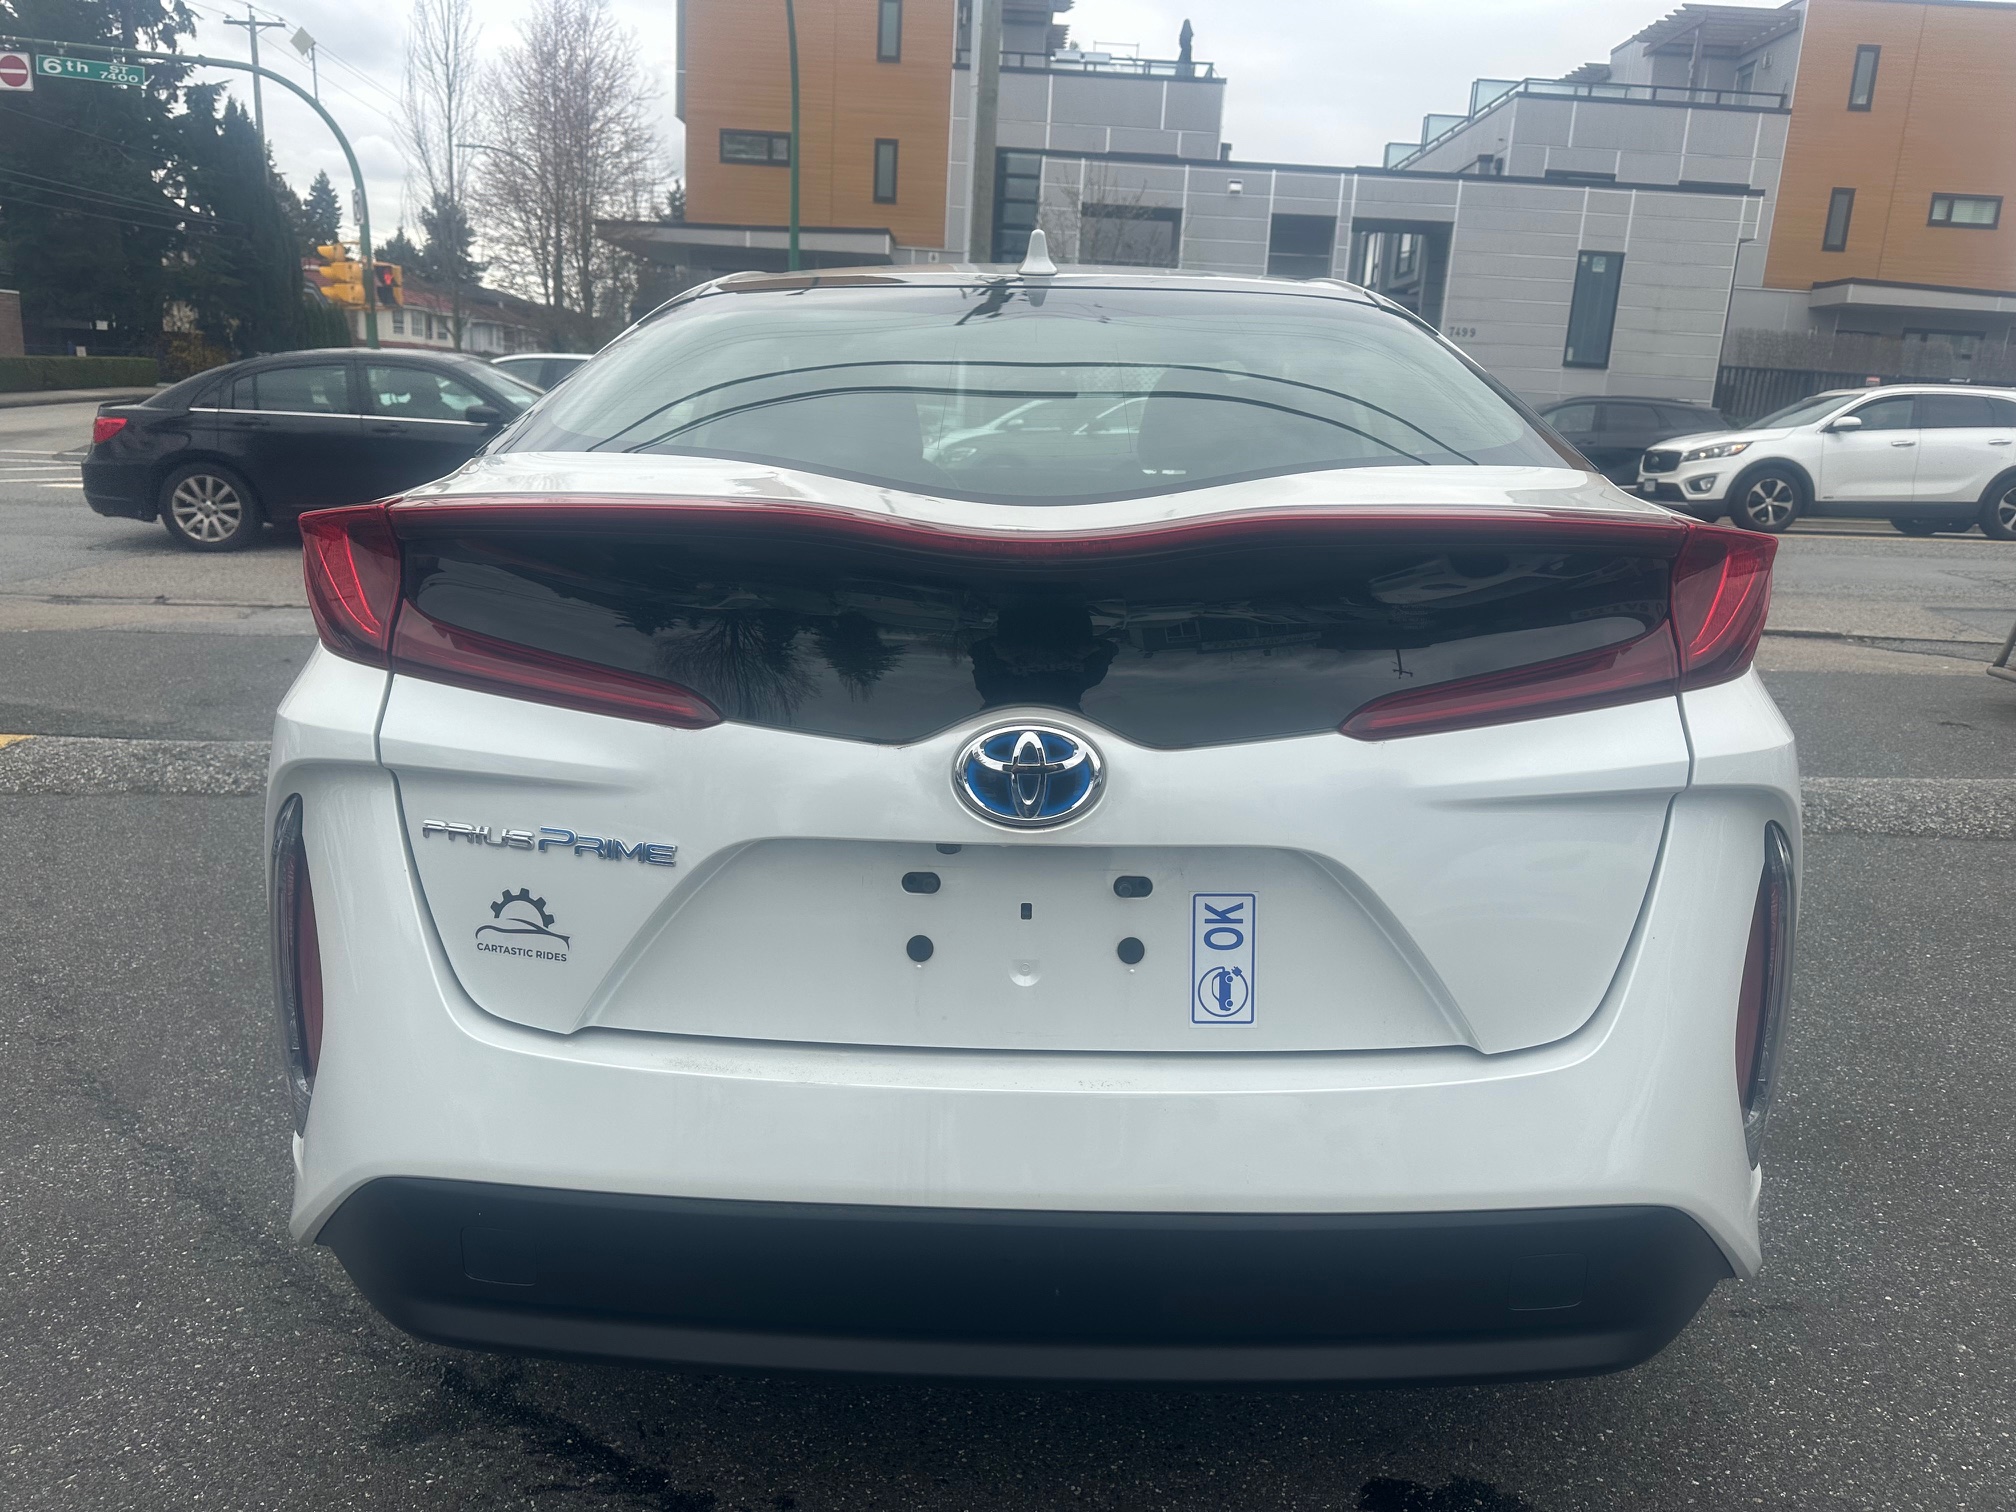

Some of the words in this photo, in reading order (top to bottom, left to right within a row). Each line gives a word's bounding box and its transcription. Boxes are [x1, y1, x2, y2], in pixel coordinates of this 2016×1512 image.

[42, 57, 89, 74] 6th
[109, 65, 129, 74] ST
[99, 71, 139, 83] 7400
[1448, 326, 1476, 338] 7499
[422, 818, 536, 851] PRIUS
[537, 824, 678, 867] PRIME
[1203, 902, 1244, 951] OK
[476, 942, 534, 958] CARTASTIC
[535, 950, 567, 962] RIDES
